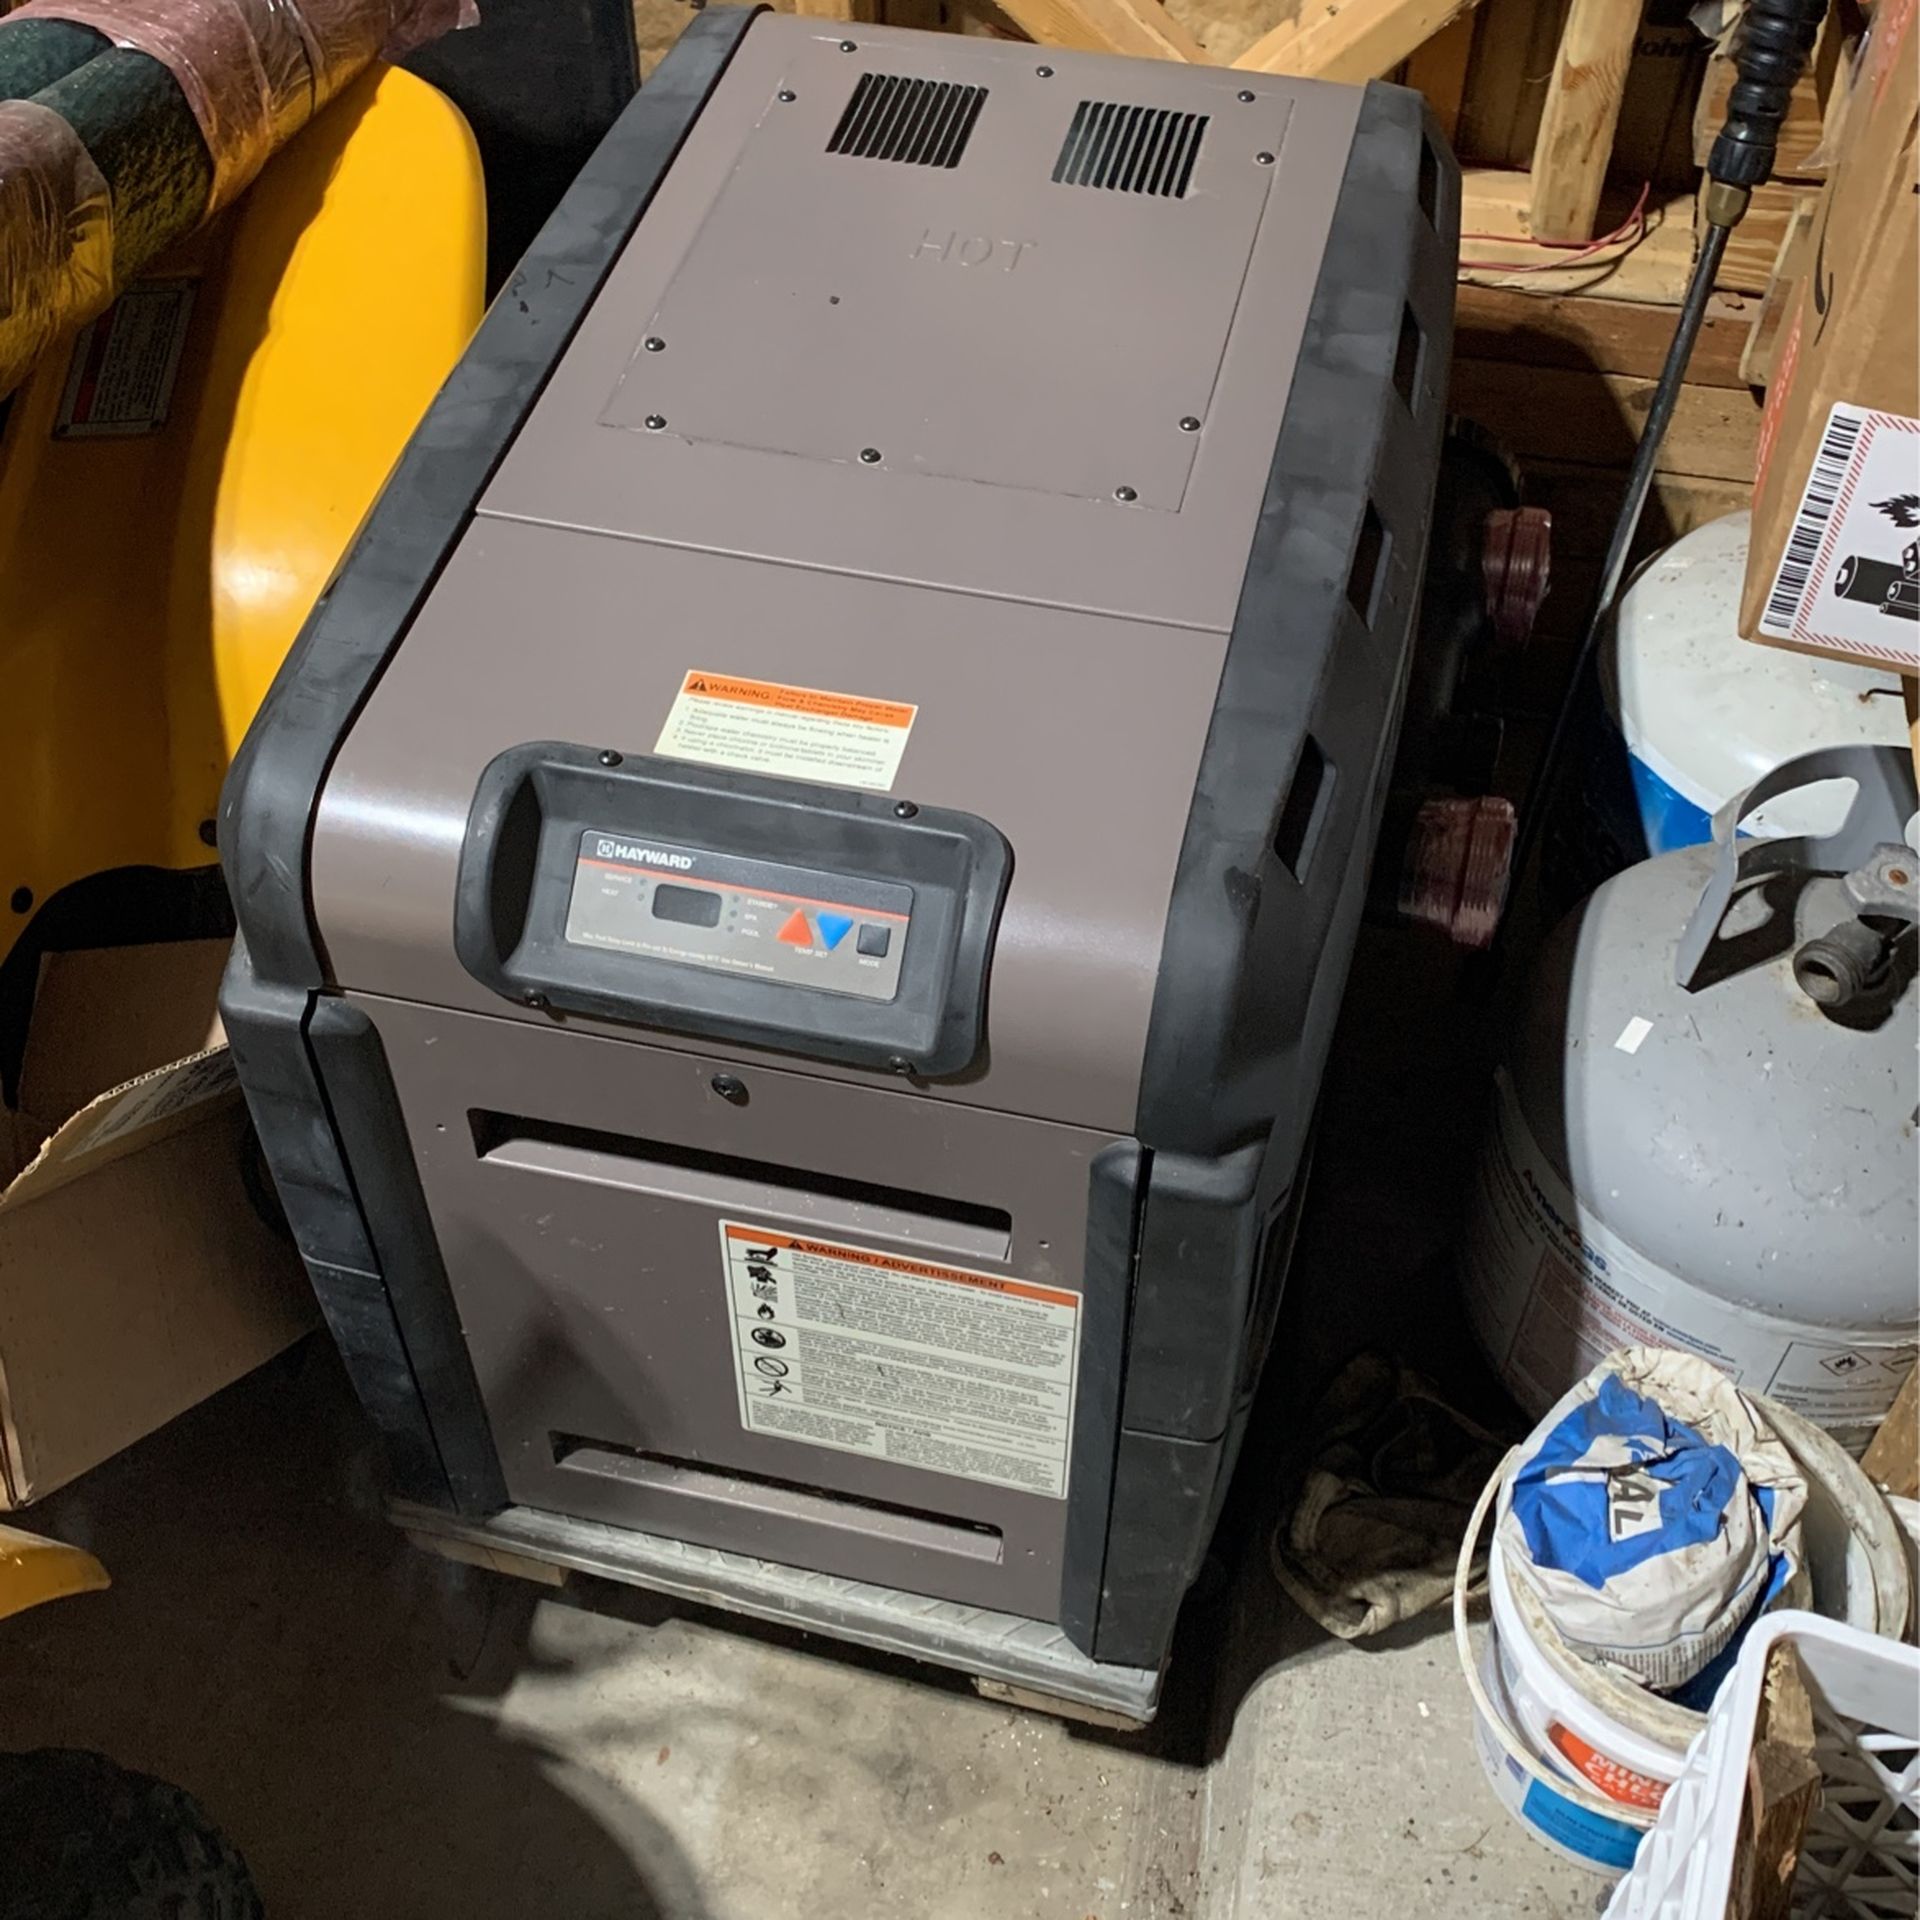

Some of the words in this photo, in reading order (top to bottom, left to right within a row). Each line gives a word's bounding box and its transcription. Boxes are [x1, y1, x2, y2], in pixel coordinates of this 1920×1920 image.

[909, 228, 1039, 271] HOT
[707, 682, 772, 700] WARNING
[615, 844, 693, 870] HAYWARD
[601, 887, 619, 897] HEAT
[741, 928, 760, 938] POOL
[858, 958, 880, 969] MODE
[1523, 1168, 1607, 1272] AmeriGas
[806, 1242, 871, 1263] WARNING
[882, 1259, 1006, 1290] ADVERTISSEMENT
